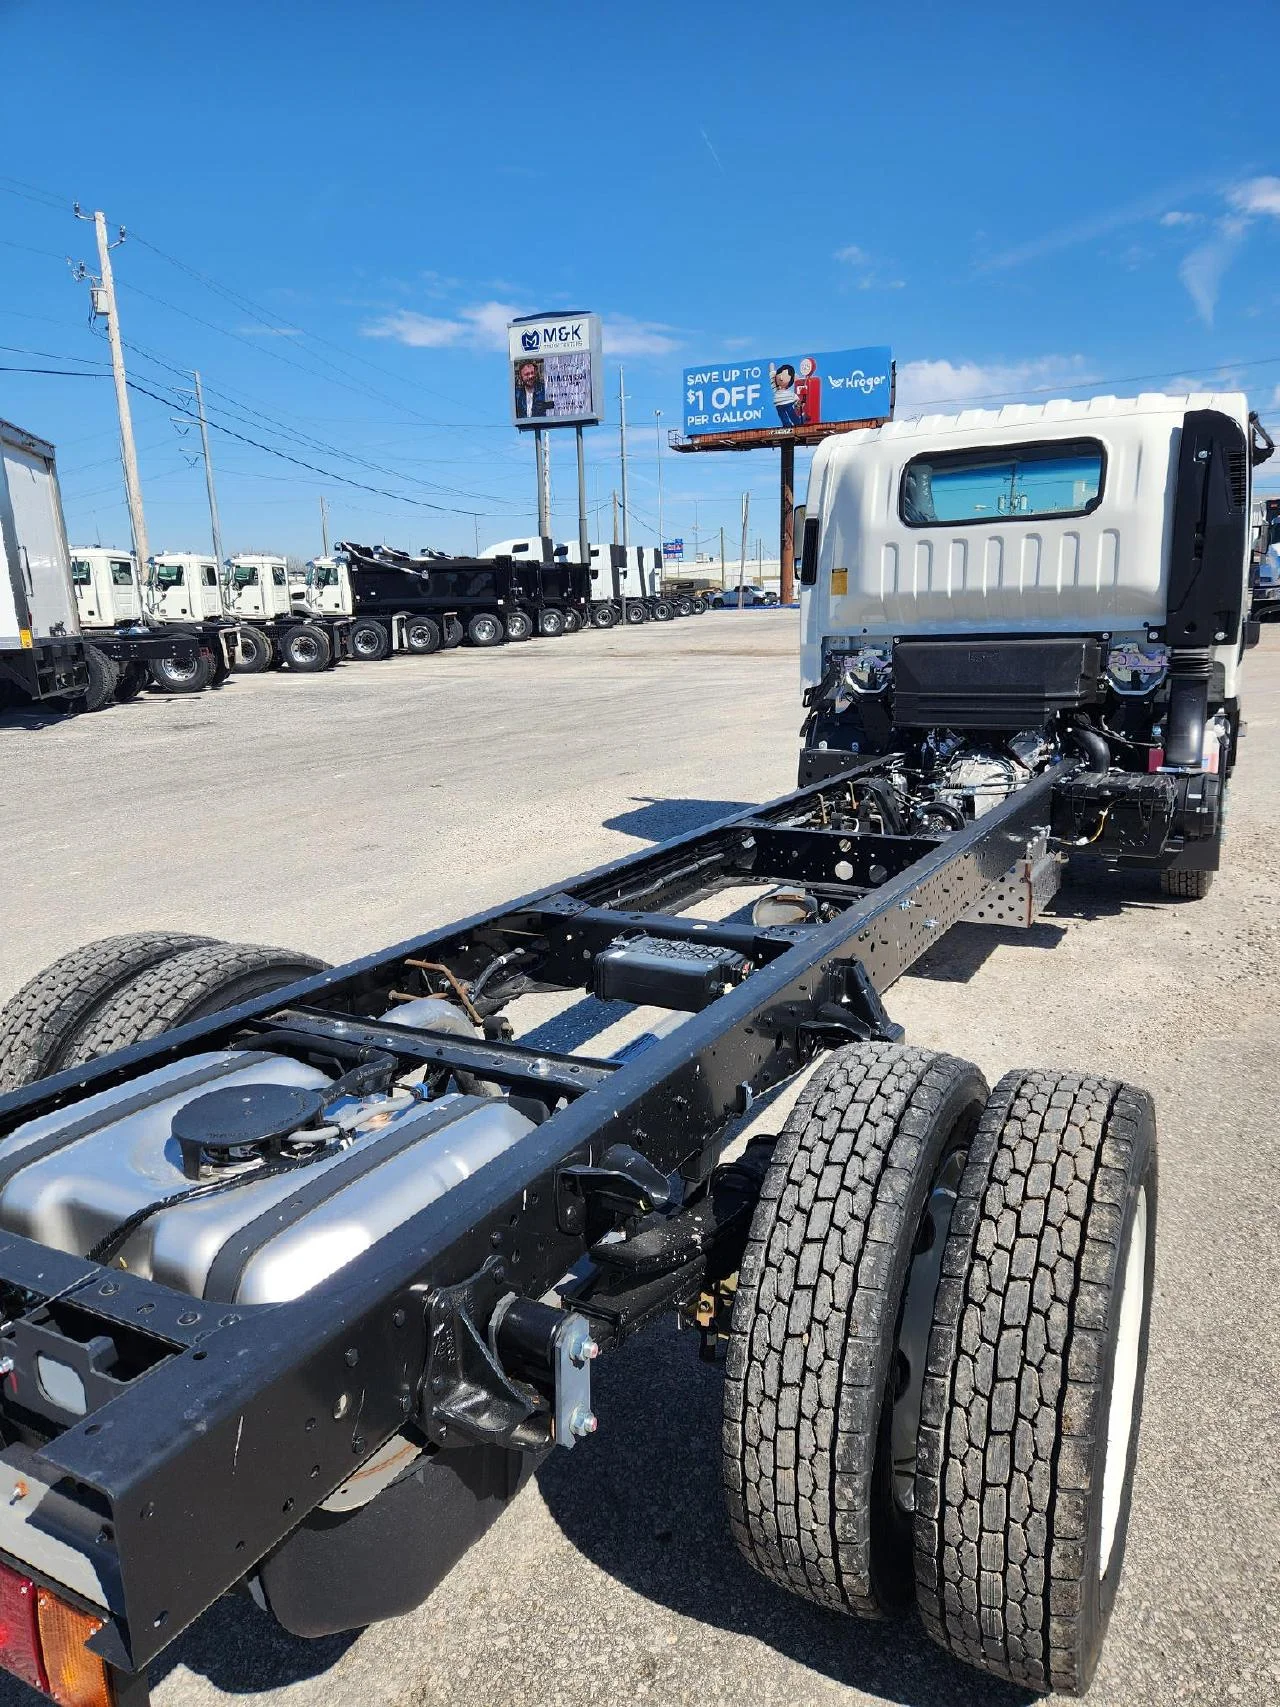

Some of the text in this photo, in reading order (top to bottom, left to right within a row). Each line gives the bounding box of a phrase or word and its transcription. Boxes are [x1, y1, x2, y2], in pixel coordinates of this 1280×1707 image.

[543, 324, 582, 342] M&K
[687, 367, 761, 385] SAVE UP TO
[846, 370, 886, 394] Kroger
[687, 384, 761, 411] $1 OFF
[687, 414, 709, 426] PER
